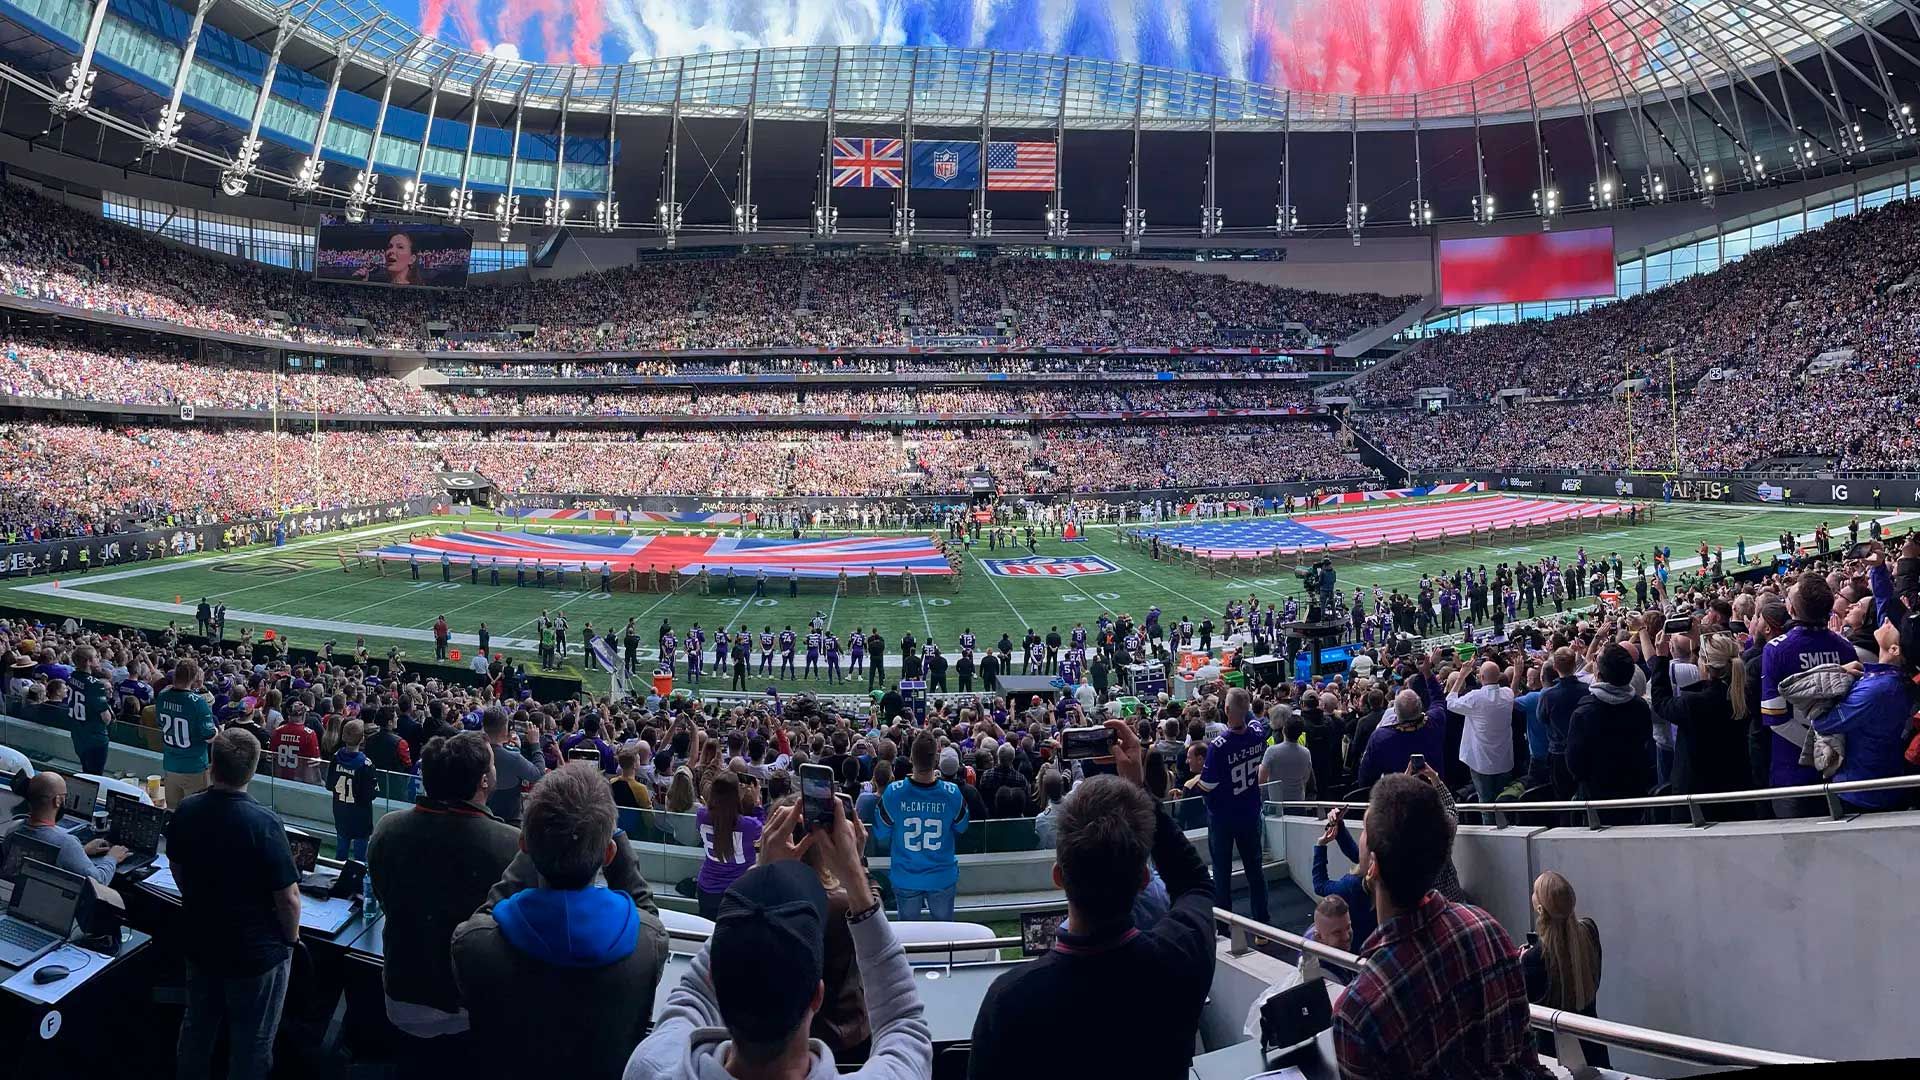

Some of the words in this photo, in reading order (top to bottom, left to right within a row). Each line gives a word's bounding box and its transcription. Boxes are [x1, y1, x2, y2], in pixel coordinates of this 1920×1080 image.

[936, 163, 957, 176] NFL
[442, 477, 475, 486] IG
[1832, 485, 1848, 500] IG
[1002, 561, 1106, 576] NFL
[963, 636, 973, 646] 12
[1126, 640, 1138, 649] 30
[1799, 651, 1841, 670] SMITH
[160, 713, 192, 749] 20
[280, 733, 301, 743] KITTLE
[277, 744, 300, 769] 85
[1231, 755, 1262, 796] 95
[334, 775, 355, 804] 41
[901, 801, 945, 813] McCAFFREY
[903, 817, 943, 852] 22
[47, 1016, 55, 1032] F
